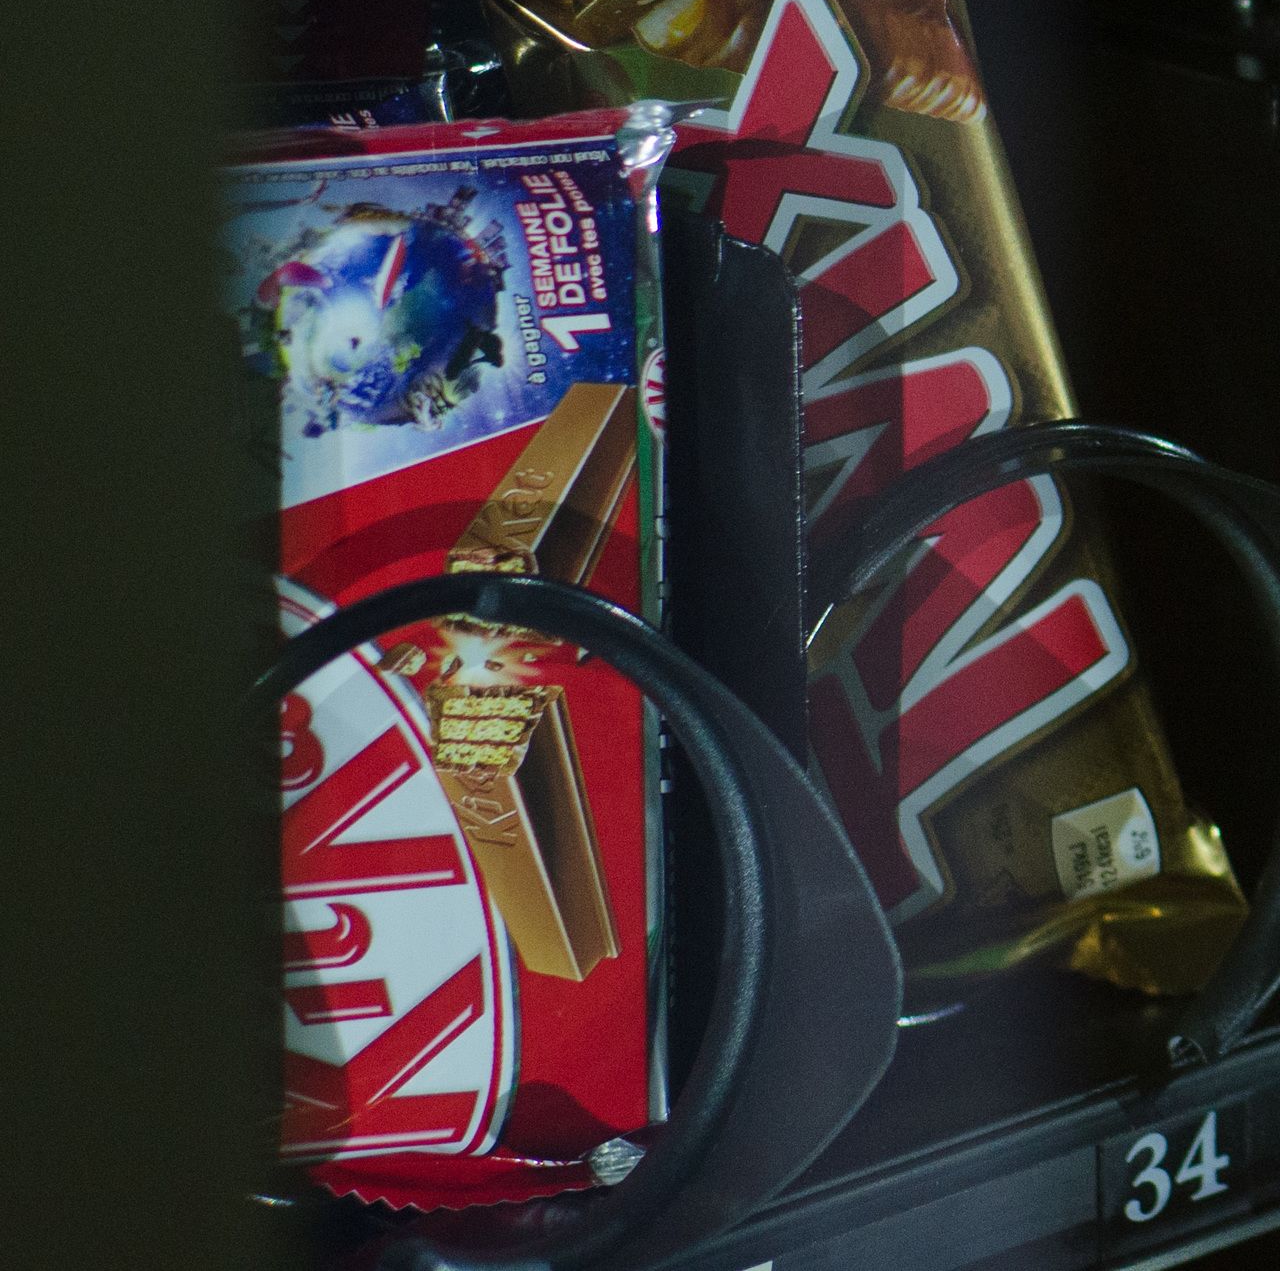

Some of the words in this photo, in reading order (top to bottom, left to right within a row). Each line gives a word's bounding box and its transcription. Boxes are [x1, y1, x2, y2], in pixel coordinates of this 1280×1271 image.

[522, 174, 578, 255] FOLIE
[580, 217, 599, 250] tes
[516, 201, 558, 308] SEMAINE
[587, 254, 608, 301] avec
[554, 261, 587, 305] DE
[513, 293, 547, 368] gagner
[540, 313, 612, 351] 1
[527, 369, 547, 385] à
[1125, 1110, 1231, 1222] 34
